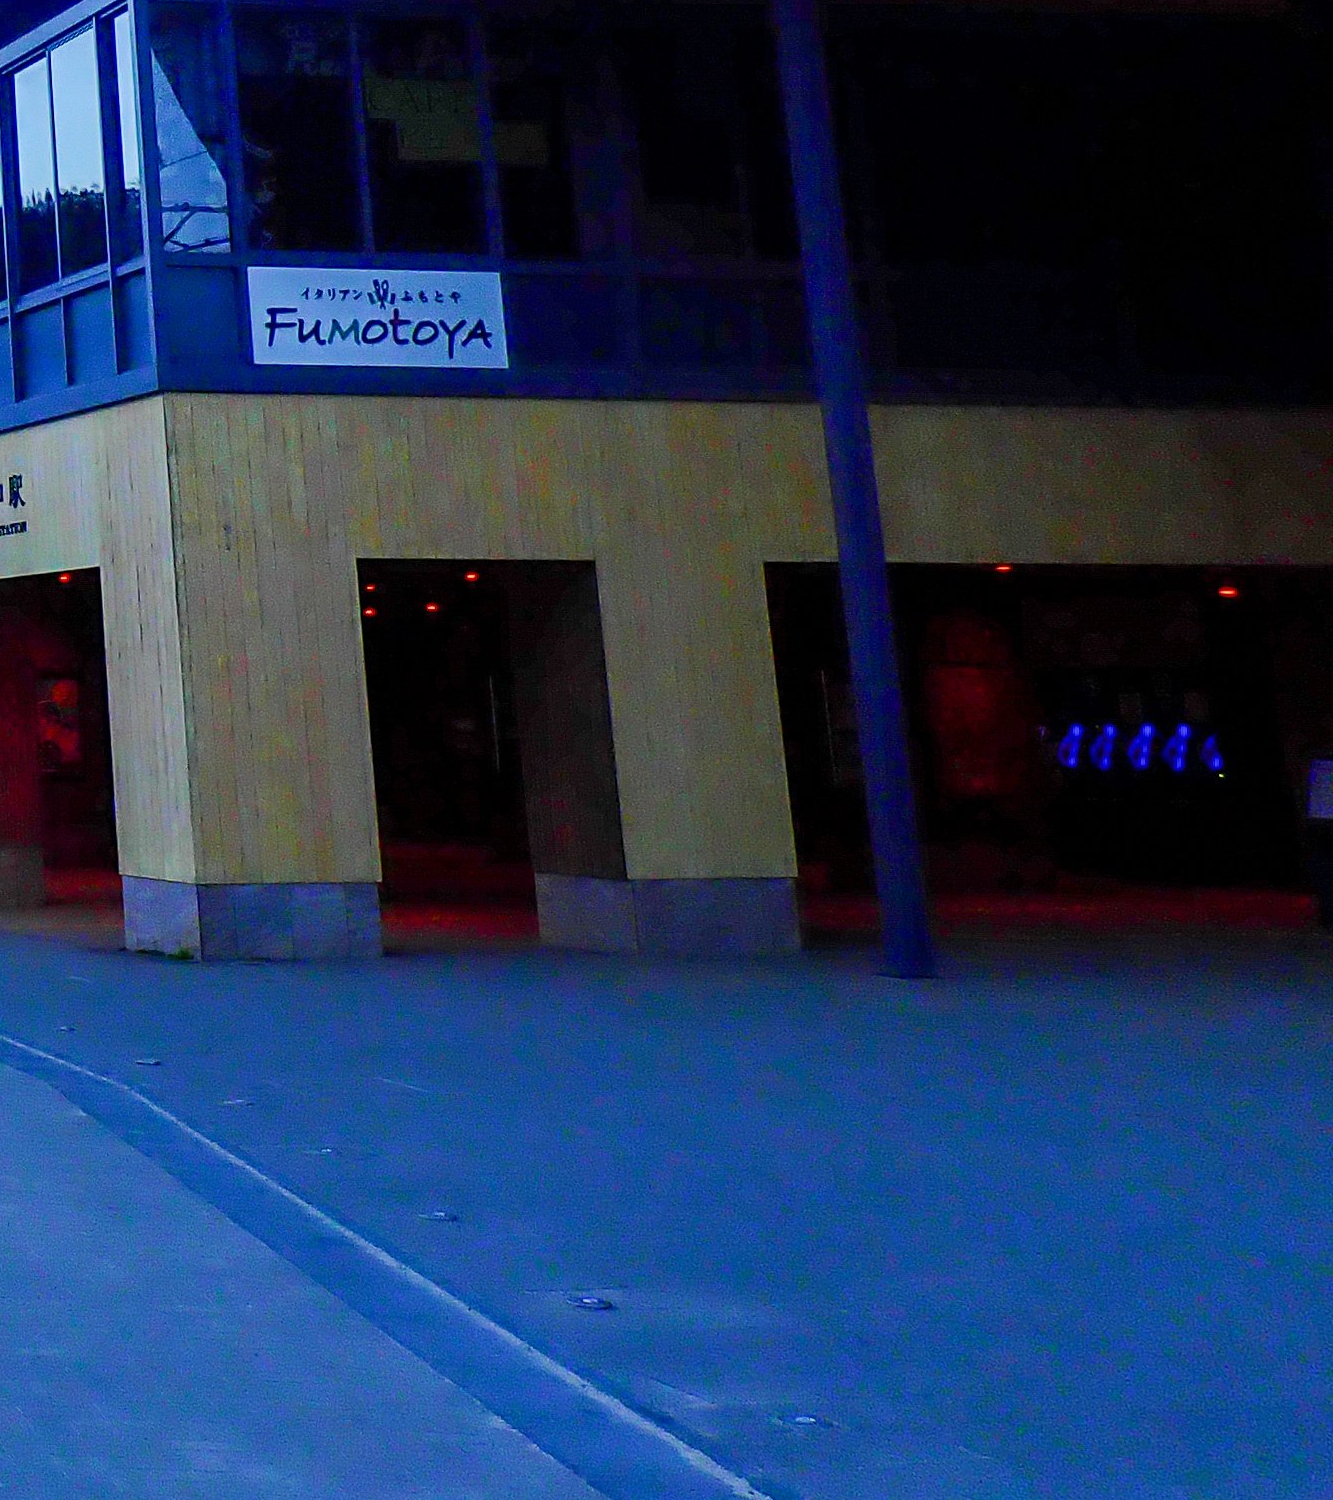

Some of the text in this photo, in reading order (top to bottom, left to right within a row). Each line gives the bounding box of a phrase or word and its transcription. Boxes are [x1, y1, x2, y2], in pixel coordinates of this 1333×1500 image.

[300, 287, 462, 304] イタリアン ふもとや
